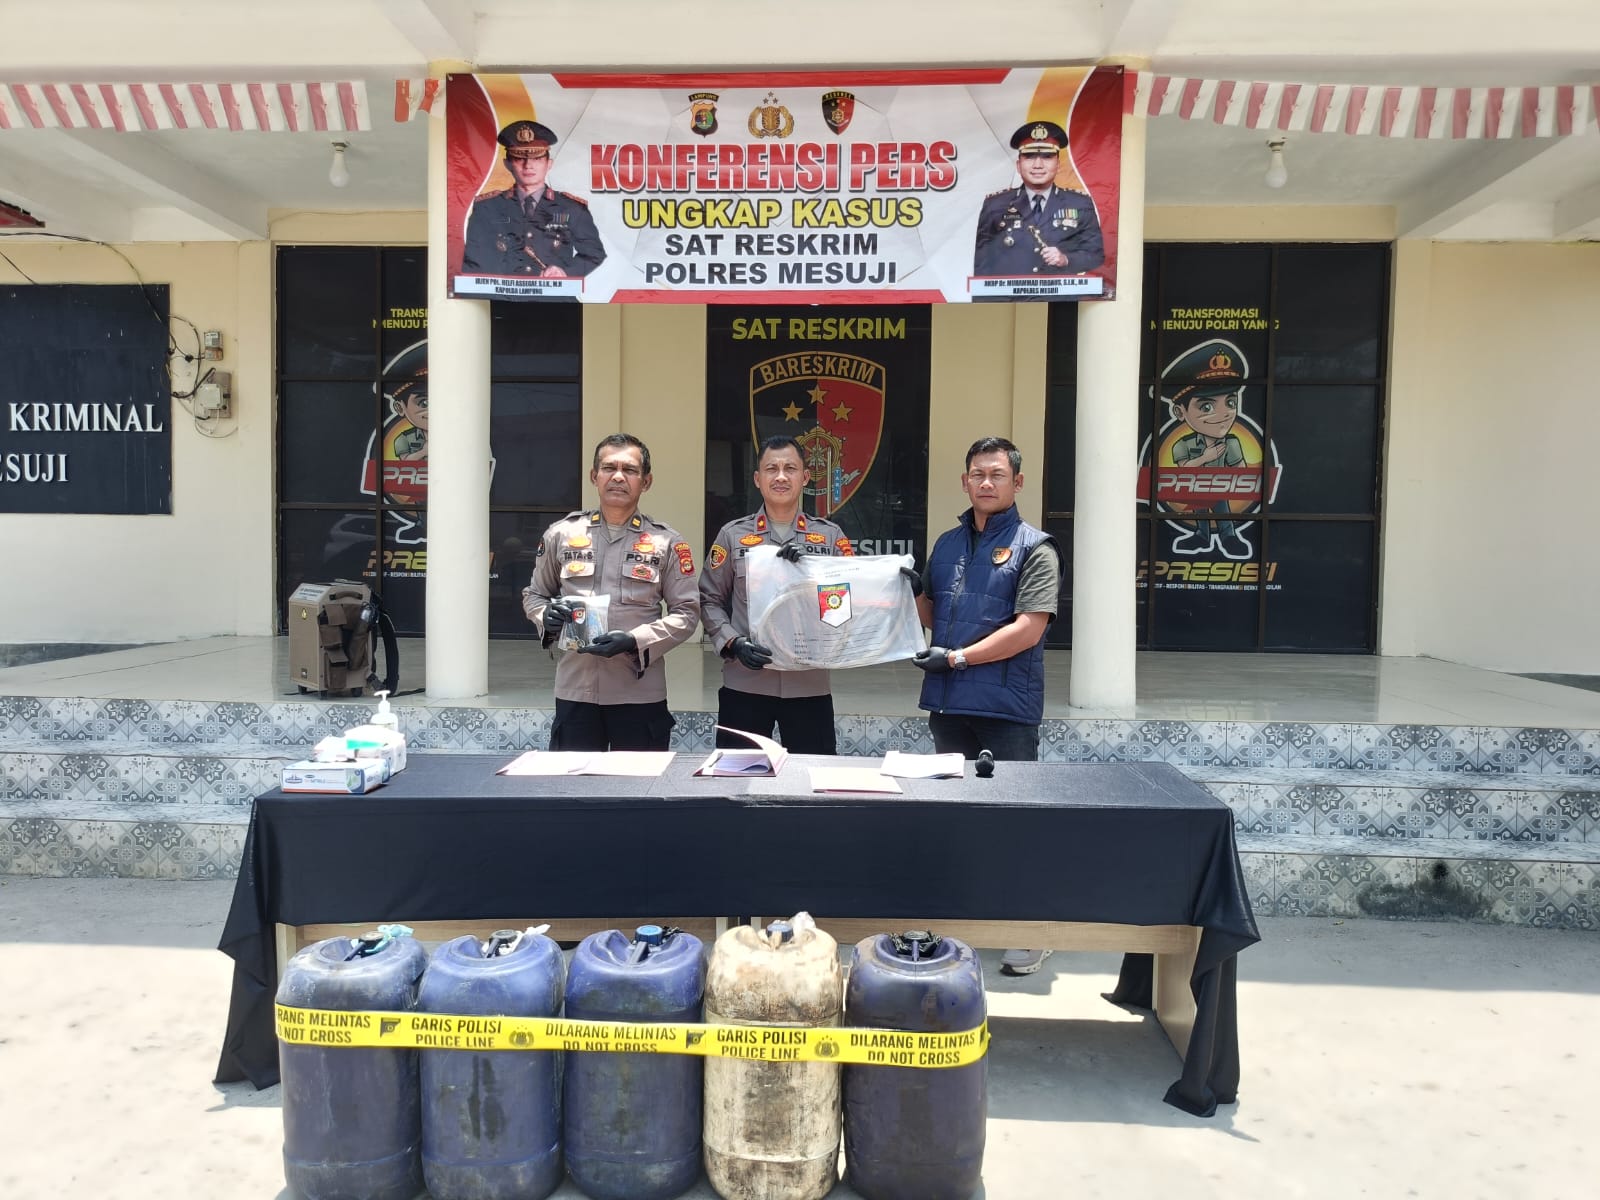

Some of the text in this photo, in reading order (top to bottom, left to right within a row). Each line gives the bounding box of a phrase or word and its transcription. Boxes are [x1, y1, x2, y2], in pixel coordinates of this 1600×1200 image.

[590, 141, 958, 193] KONFERENSI PERS
[623, 197, 923, 228] UNGKAP KASUS
[665, 233, 878, 256] SAT RESKRIM
[645, 261, 896, 285] POLRES MESUJI
[1171, 308, 1259, 319] TRANSFORMASI
[732, 317, 906, 340] SAT RESKRIM
[1205, 319, 1239, 330] POLRI
[760, 354, 876, 384] BARESKRIM
[9, 402, 163, 433] KRIMINAL
[0, 453, 69, 482] SUJI
[1158, 473, 1261, 493] PRESISI
[626, 553, 660, 565] POLRI
[807, 546, 831, 555] OLRI
[1137, 560, 1278, 582] PRESISI
[277, 1008, 371, 1029] RANG MELINTAS
[411, 1017, 502, 1034] GARIS POLISI
[284, 1026, 306, 1041] NOT
[310, 1028, 352, 1044] CROSS
[546, 1023, 677, 1041] DILARANG MELINTAS
[717, 1028, 807, 1045] GARIS POLISI
[850, 1032, 976, 1049] DILARANG MELINTAS
[416, 1034, 496, 1049] POLICE LINE
[615, 1043, 657, 1053] CROSS
[721, 1045, 801, 1060] POLICE LINE
[868, 1050, 960, 1065] DO NOT CROSS
